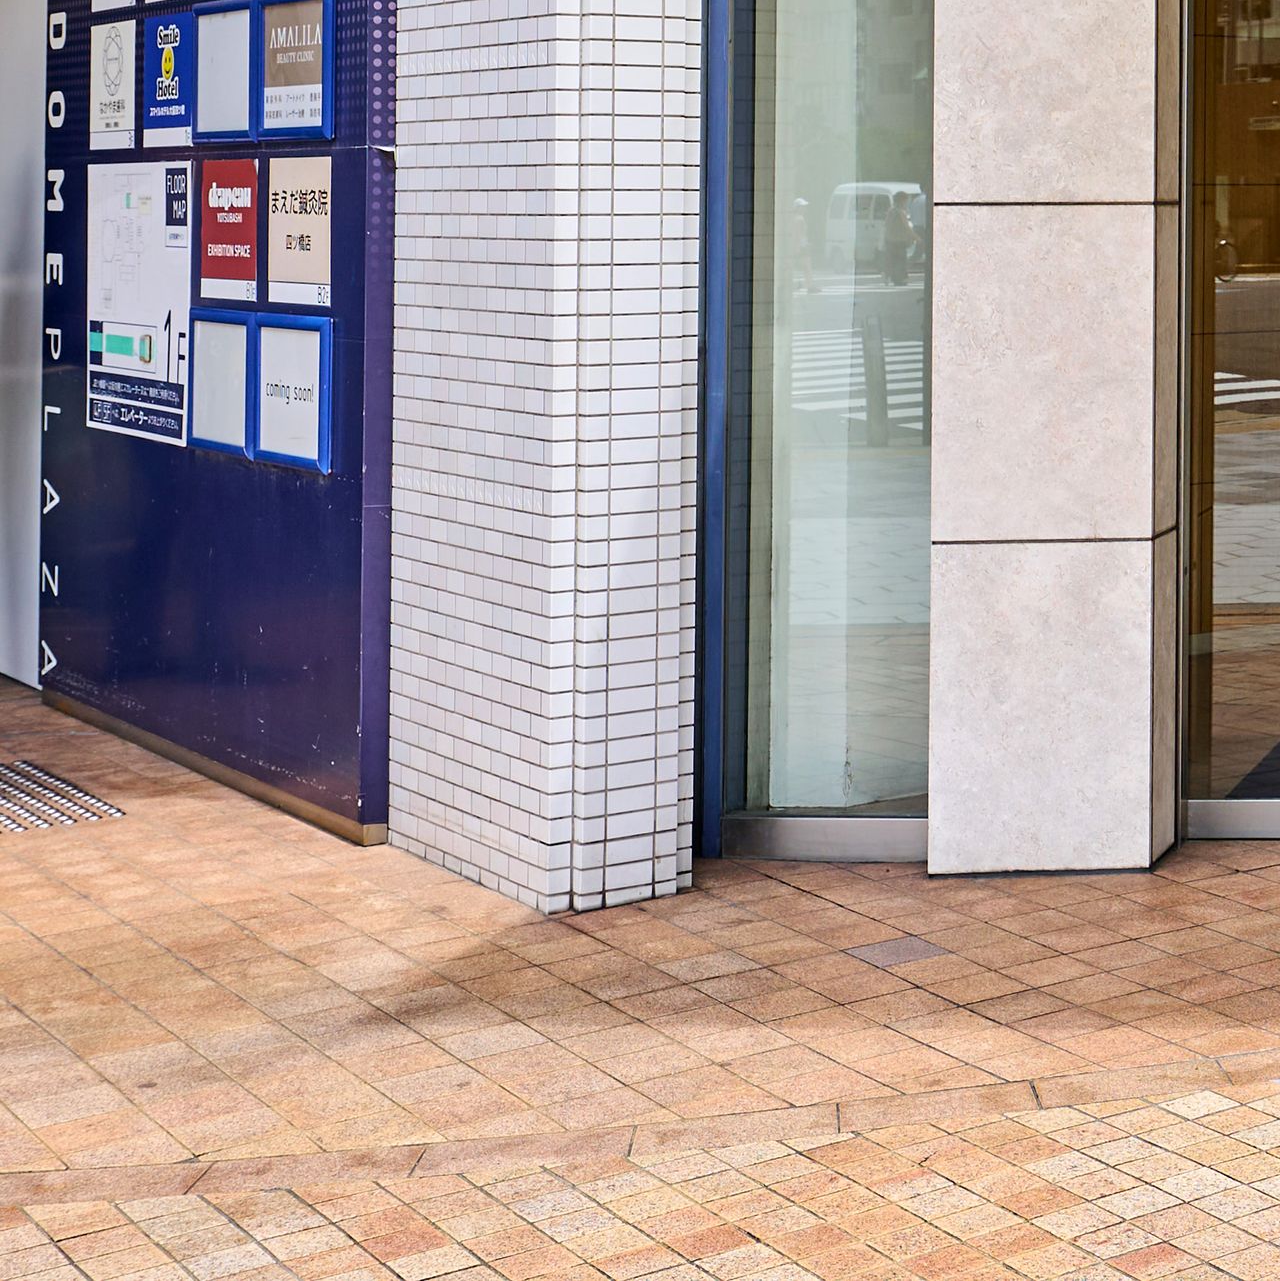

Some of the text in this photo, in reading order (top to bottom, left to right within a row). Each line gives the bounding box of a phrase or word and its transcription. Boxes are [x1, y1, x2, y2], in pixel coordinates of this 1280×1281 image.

[158, 26, 180, 47] Smile
[157, 78, 179, 98] Hotel
[167, 175, 186, 194] FLOOR
[172, 200, 186, 219] MAP
[271, 189, 328, 216] まえだ鍼灸院
[234, 244, 251, 258] SPACE
[164, 309, 186, 384] 1F
[266, 379, 314, 405] coming soon!
